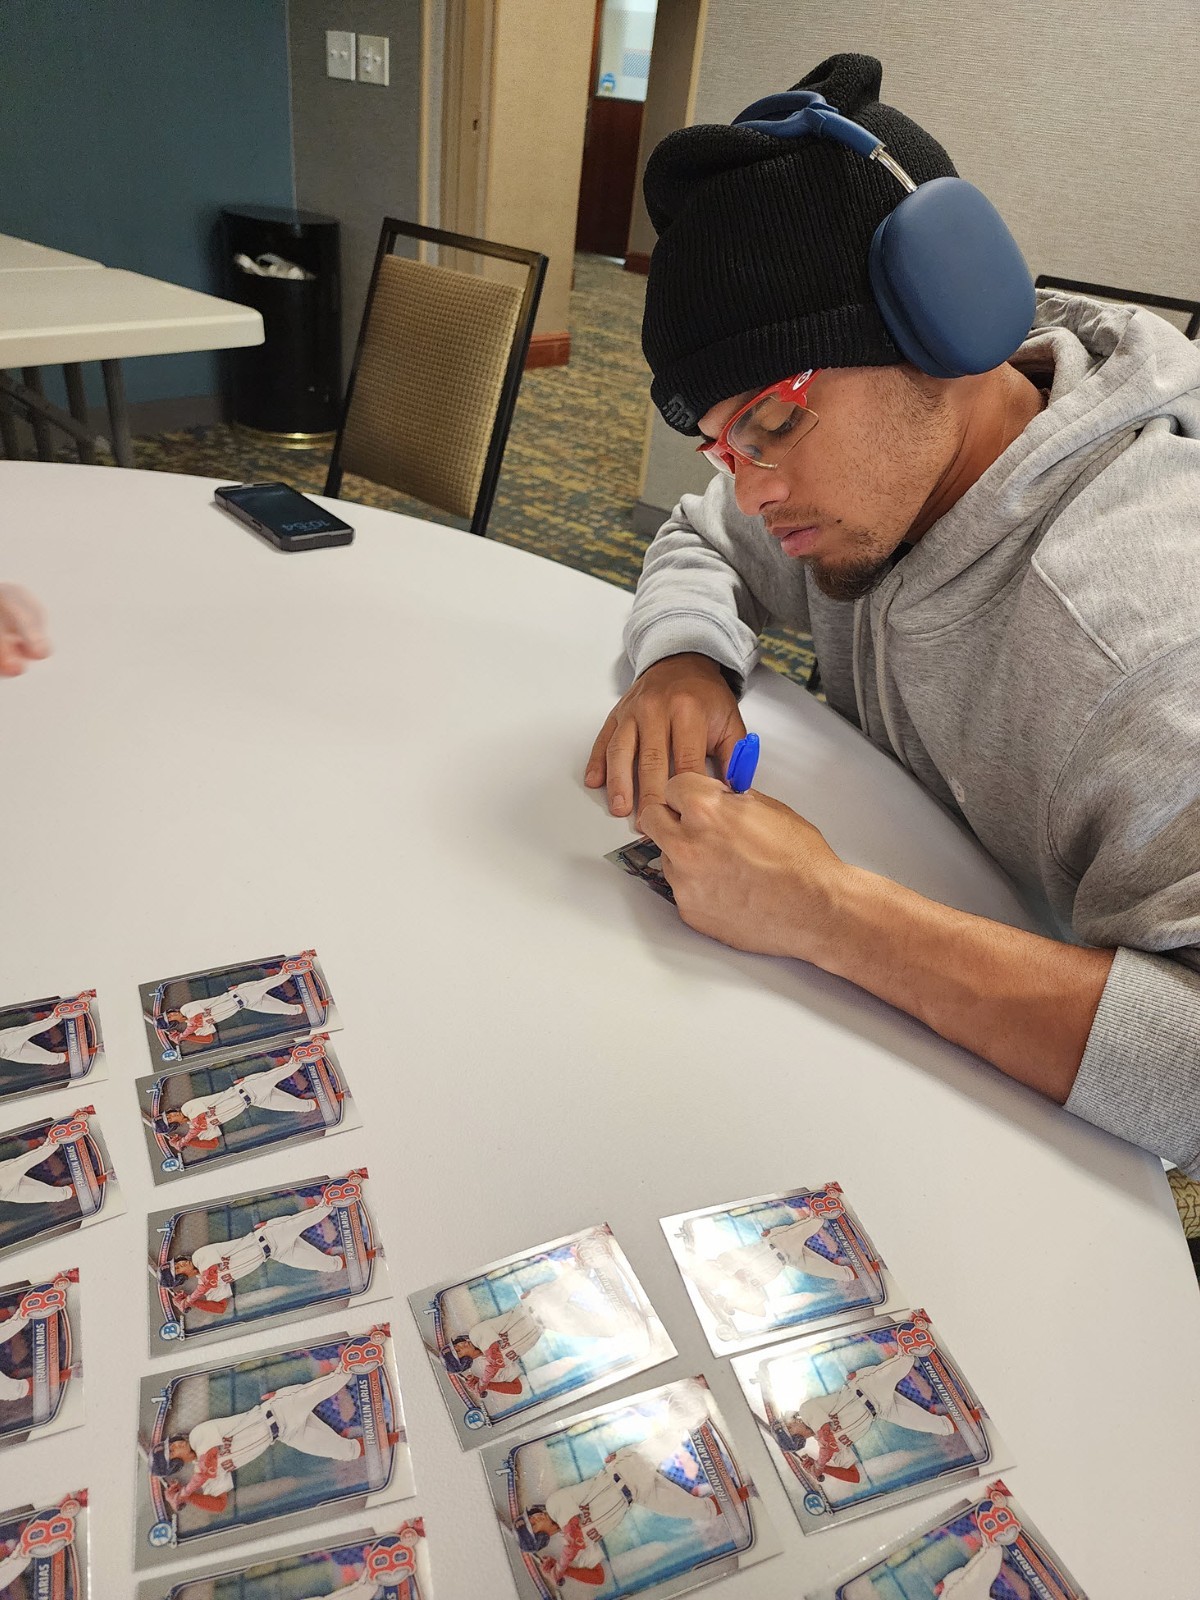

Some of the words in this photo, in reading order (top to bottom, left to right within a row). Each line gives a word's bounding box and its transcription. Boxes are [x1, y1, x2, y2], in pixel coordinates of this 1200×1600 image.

[339, 1210, 350, 1228] ARIAS
[342, 1228, 356, 1260] FRANKLIN
[35, 1323, 46, 1344] ARIAS
[35, 1344, 46, 1383] FRANKLIN
[923, 1361, 941, 1385] ARIAS
[358, 1379, 369, 1403] ARIAS
[936, 1383, 963, 1421] FRANKLIN
[362, 1403, 376, 1446] FRANKLIN
[692, 1434, 708, 1459] ARIAS
[703, 1459, 728, 1503] FRANKLIN
[1011, 1548, 1037, 1577] ARIAS
[38, 1563, 51, 1594] ARIAS
